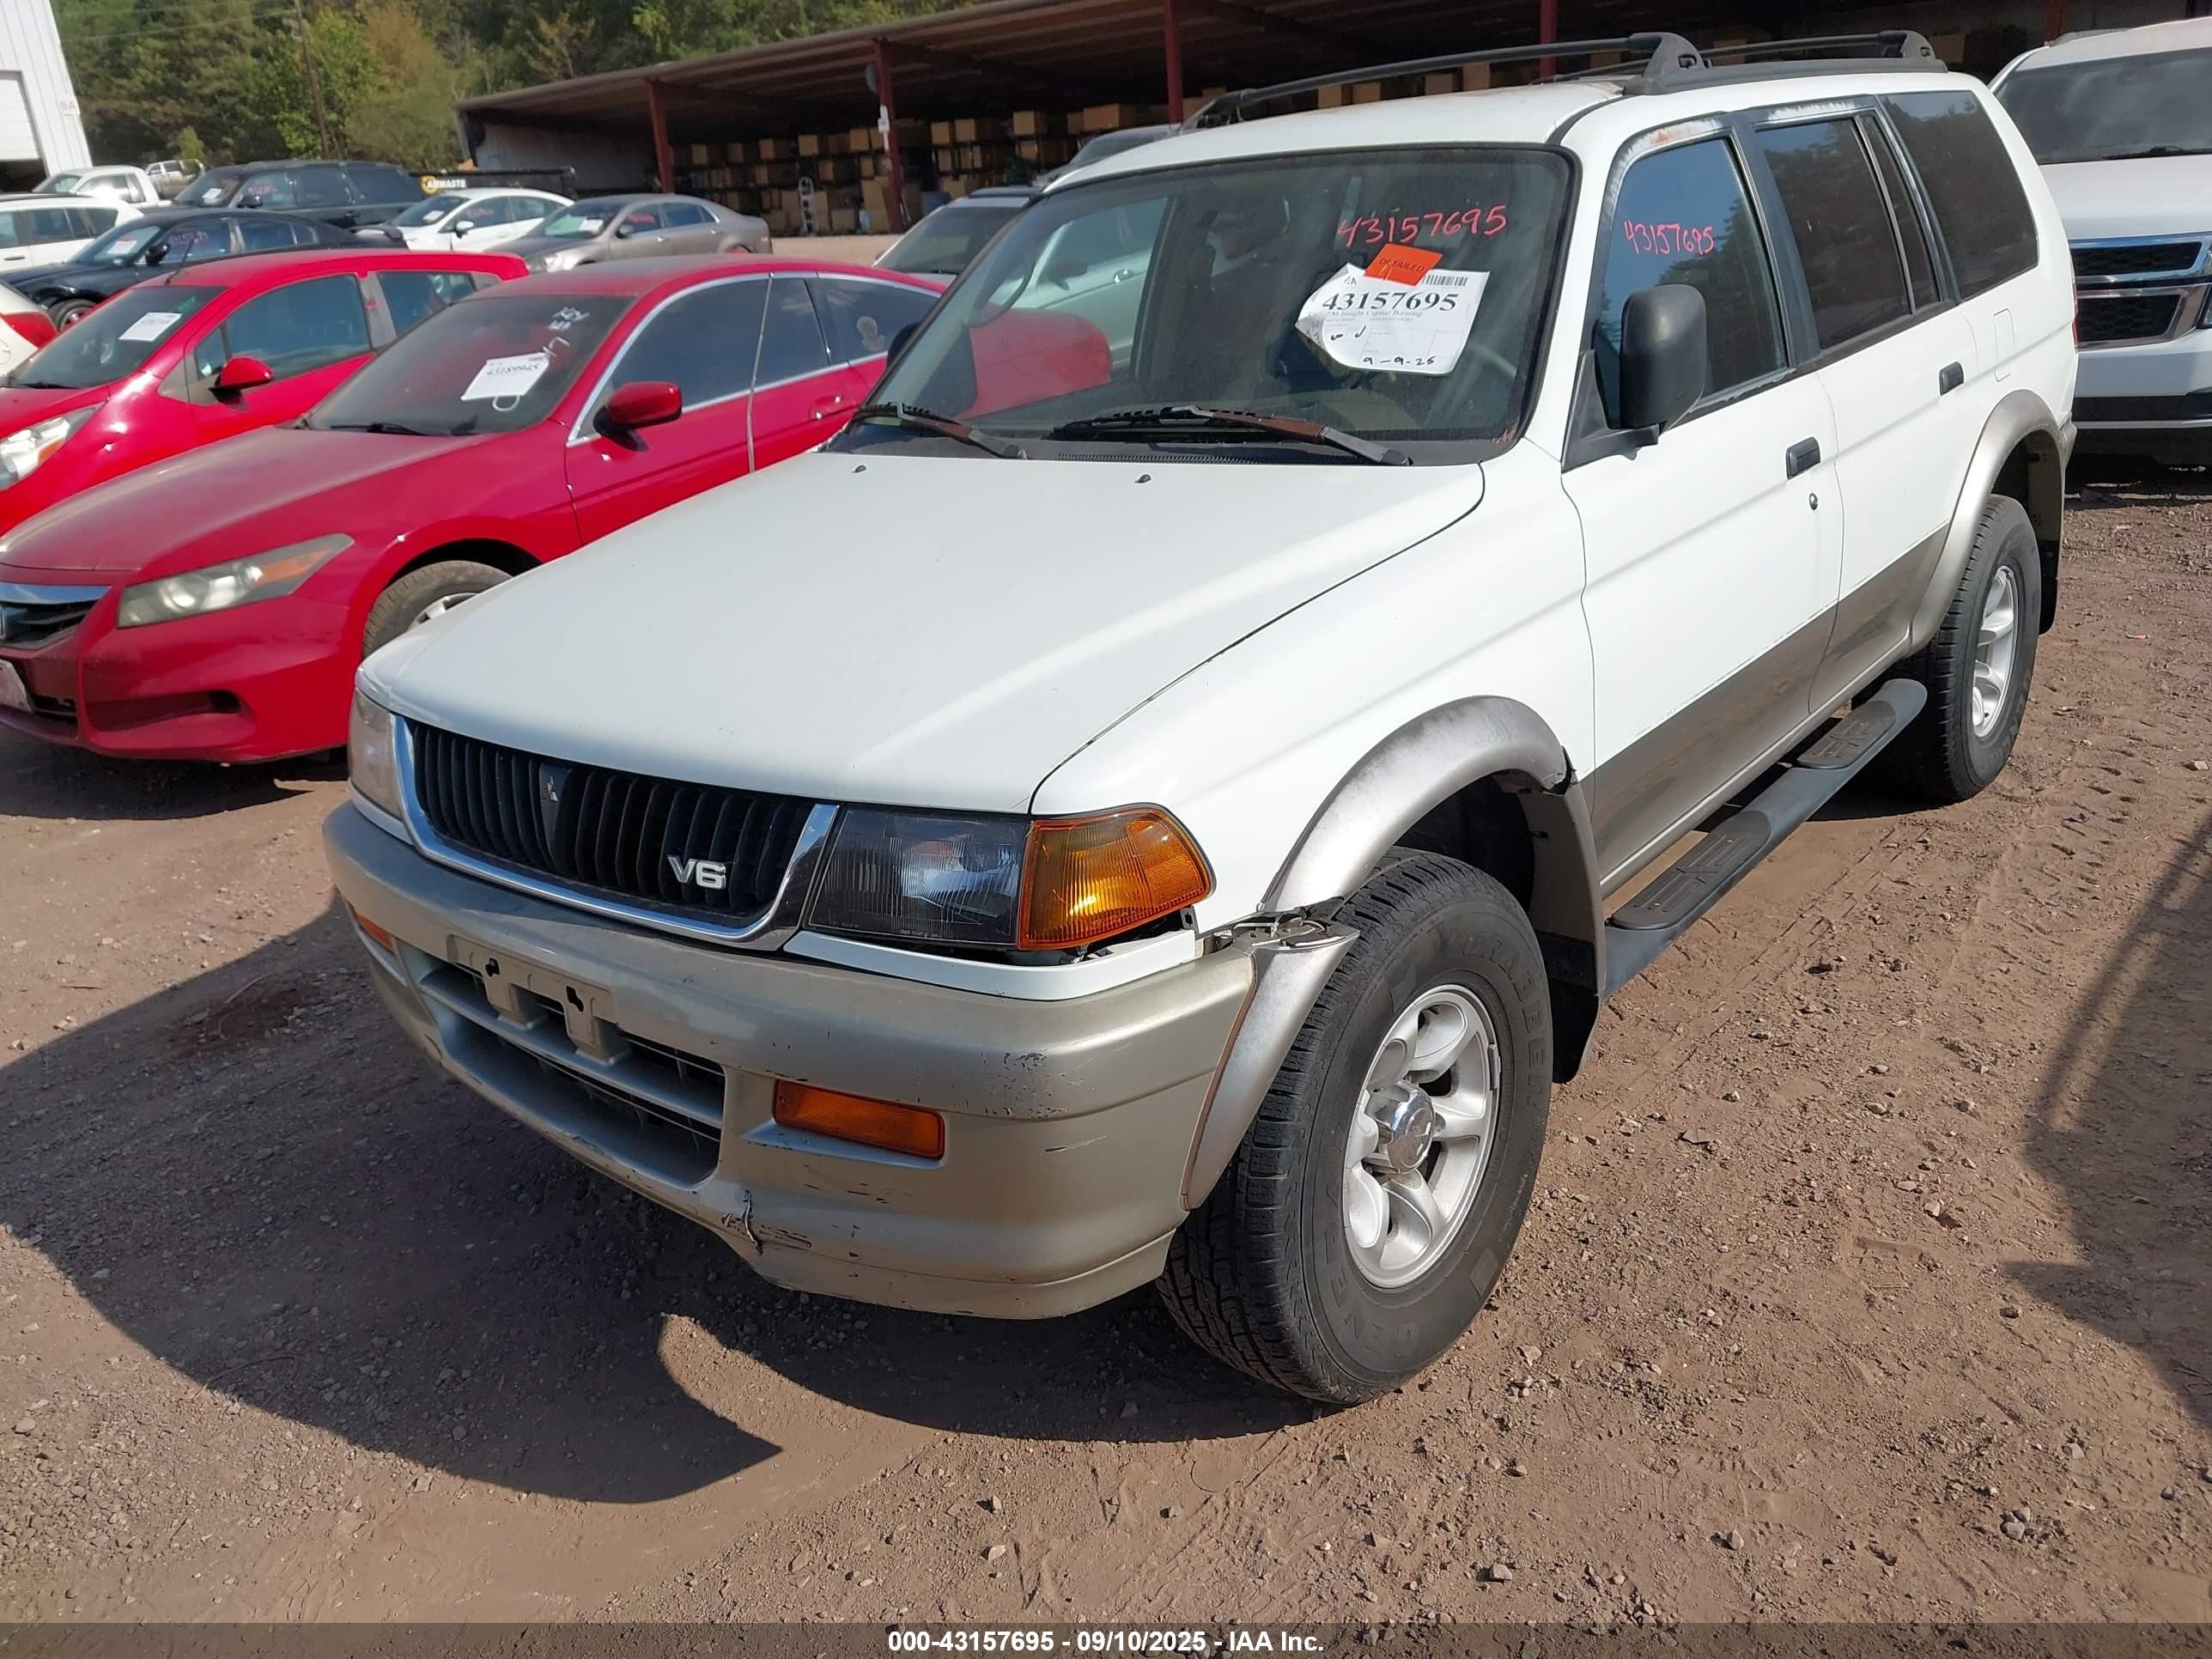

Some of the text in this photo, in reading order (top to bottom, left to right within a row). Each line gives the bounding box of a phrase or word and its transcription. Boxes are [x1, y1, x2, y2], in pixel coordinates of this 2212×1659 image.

[1337, 205, 1507, 247] 43157695
[1623, 220, 1715, 255] 43157695
[1378, 258, 1426, 272] DETAILED
[1322, 291, 1459, 311] 43157695
[666, 854, 726, 890] V6
